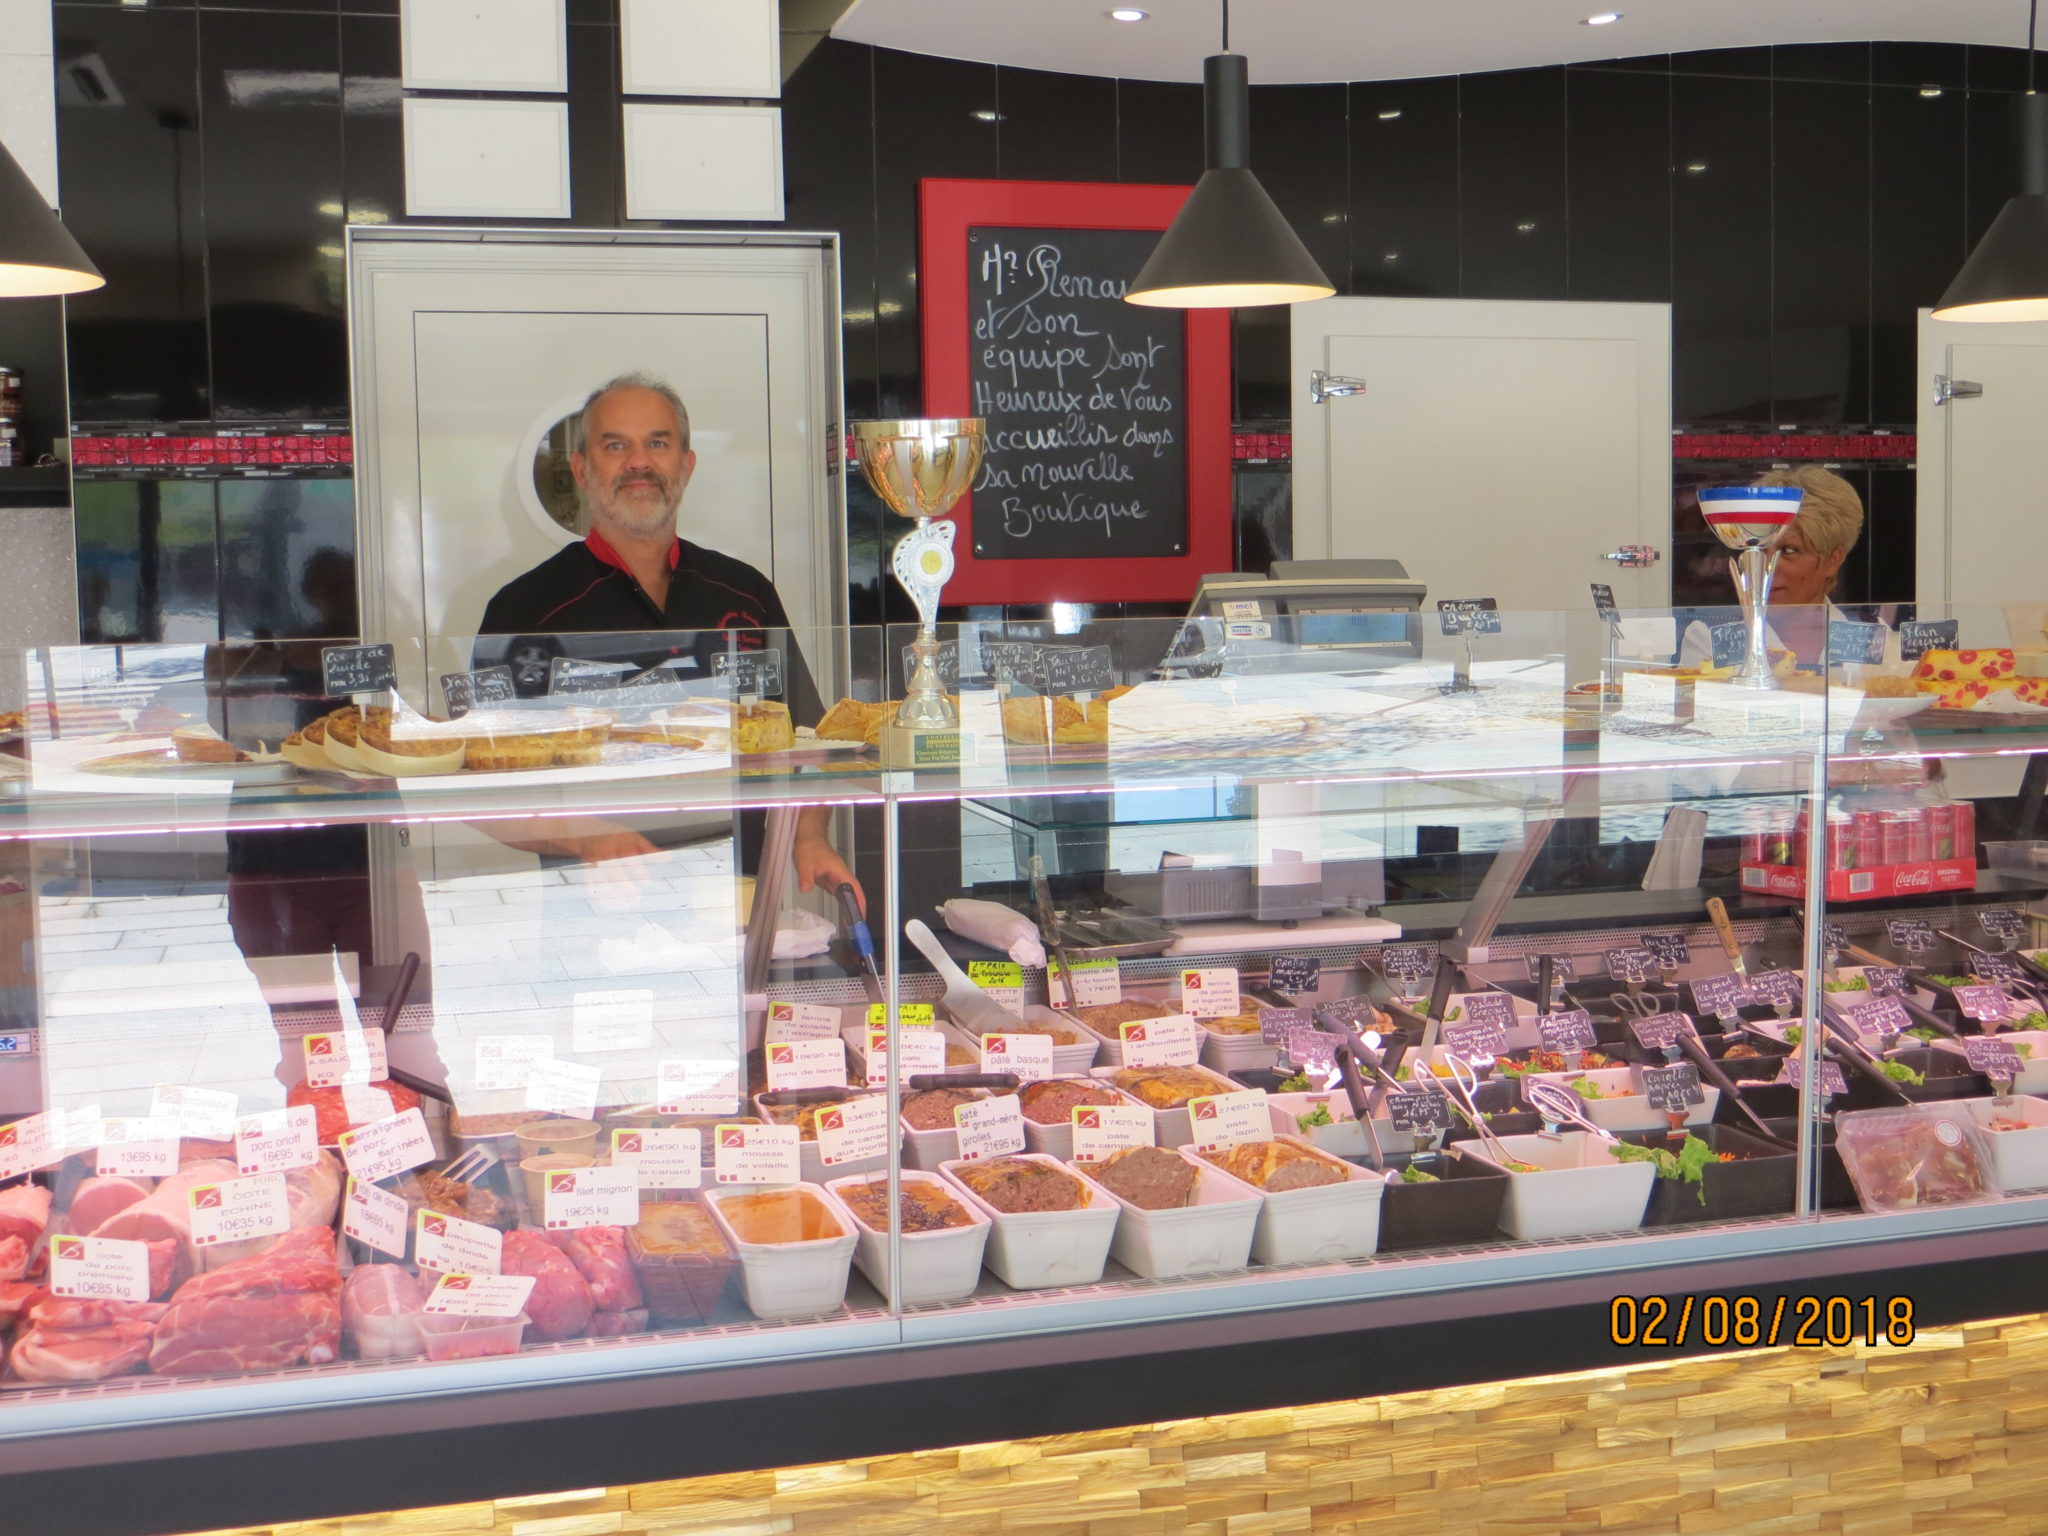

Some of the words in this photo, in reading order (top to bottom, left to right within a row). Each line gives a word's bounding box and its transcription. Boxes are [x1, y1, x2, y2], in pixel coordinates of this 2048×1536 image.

[1008, 304, 1099, 340] son
[983, 341, 1090, 388] équipe
[1089, 384, 1114, 408] de
[1002, 492, 1149, 539] Boutique
[1896, 870, 1931, 887] Coca-Cola
[828, 1050, 841, 1060] kg
[1017, 1054, 1050, 1065] basque
[1252, 1100, 1265, 1110] kg
[295, 1115, 309, 1127] de
[1135, 1119, 1147, 1129] kg
[1235, 1125, 1260, 1138] lapin
[783, 1138, 795, 1147] kg
[857, 1132, 888, 1145] canar
[1011, 1137, 1021, 1149] kg
[251, 1138, 273, 1153] porc
[345, 1147, 360, 1158] de
[363, 1138, 387, 1153] porc
[683, 1142, 696, 1151] kg
[858, 1140, 888, 1154] morill
[121, 1151, 151, 1164] 13€95
[154, 1151, 166, 1164] kg
[300, 1149, 313, 1162] kg
[736, 1161, 749, 1169] de
[577, 1186, 594, 1197] filet
[597, 1183, 633, 1197] mignon
[221, 1200, 273, 1217] ECHINE
[564, 1206, 595, 1218] 19€25
[597, 1205, 609, 1217] kg
[218, 1217, 256, 1232] 10€35
[259, 1215, 273, 1229] kg
[383, 1222, 395, 1234] kg
[116, 1283, 131, 1298] kg
